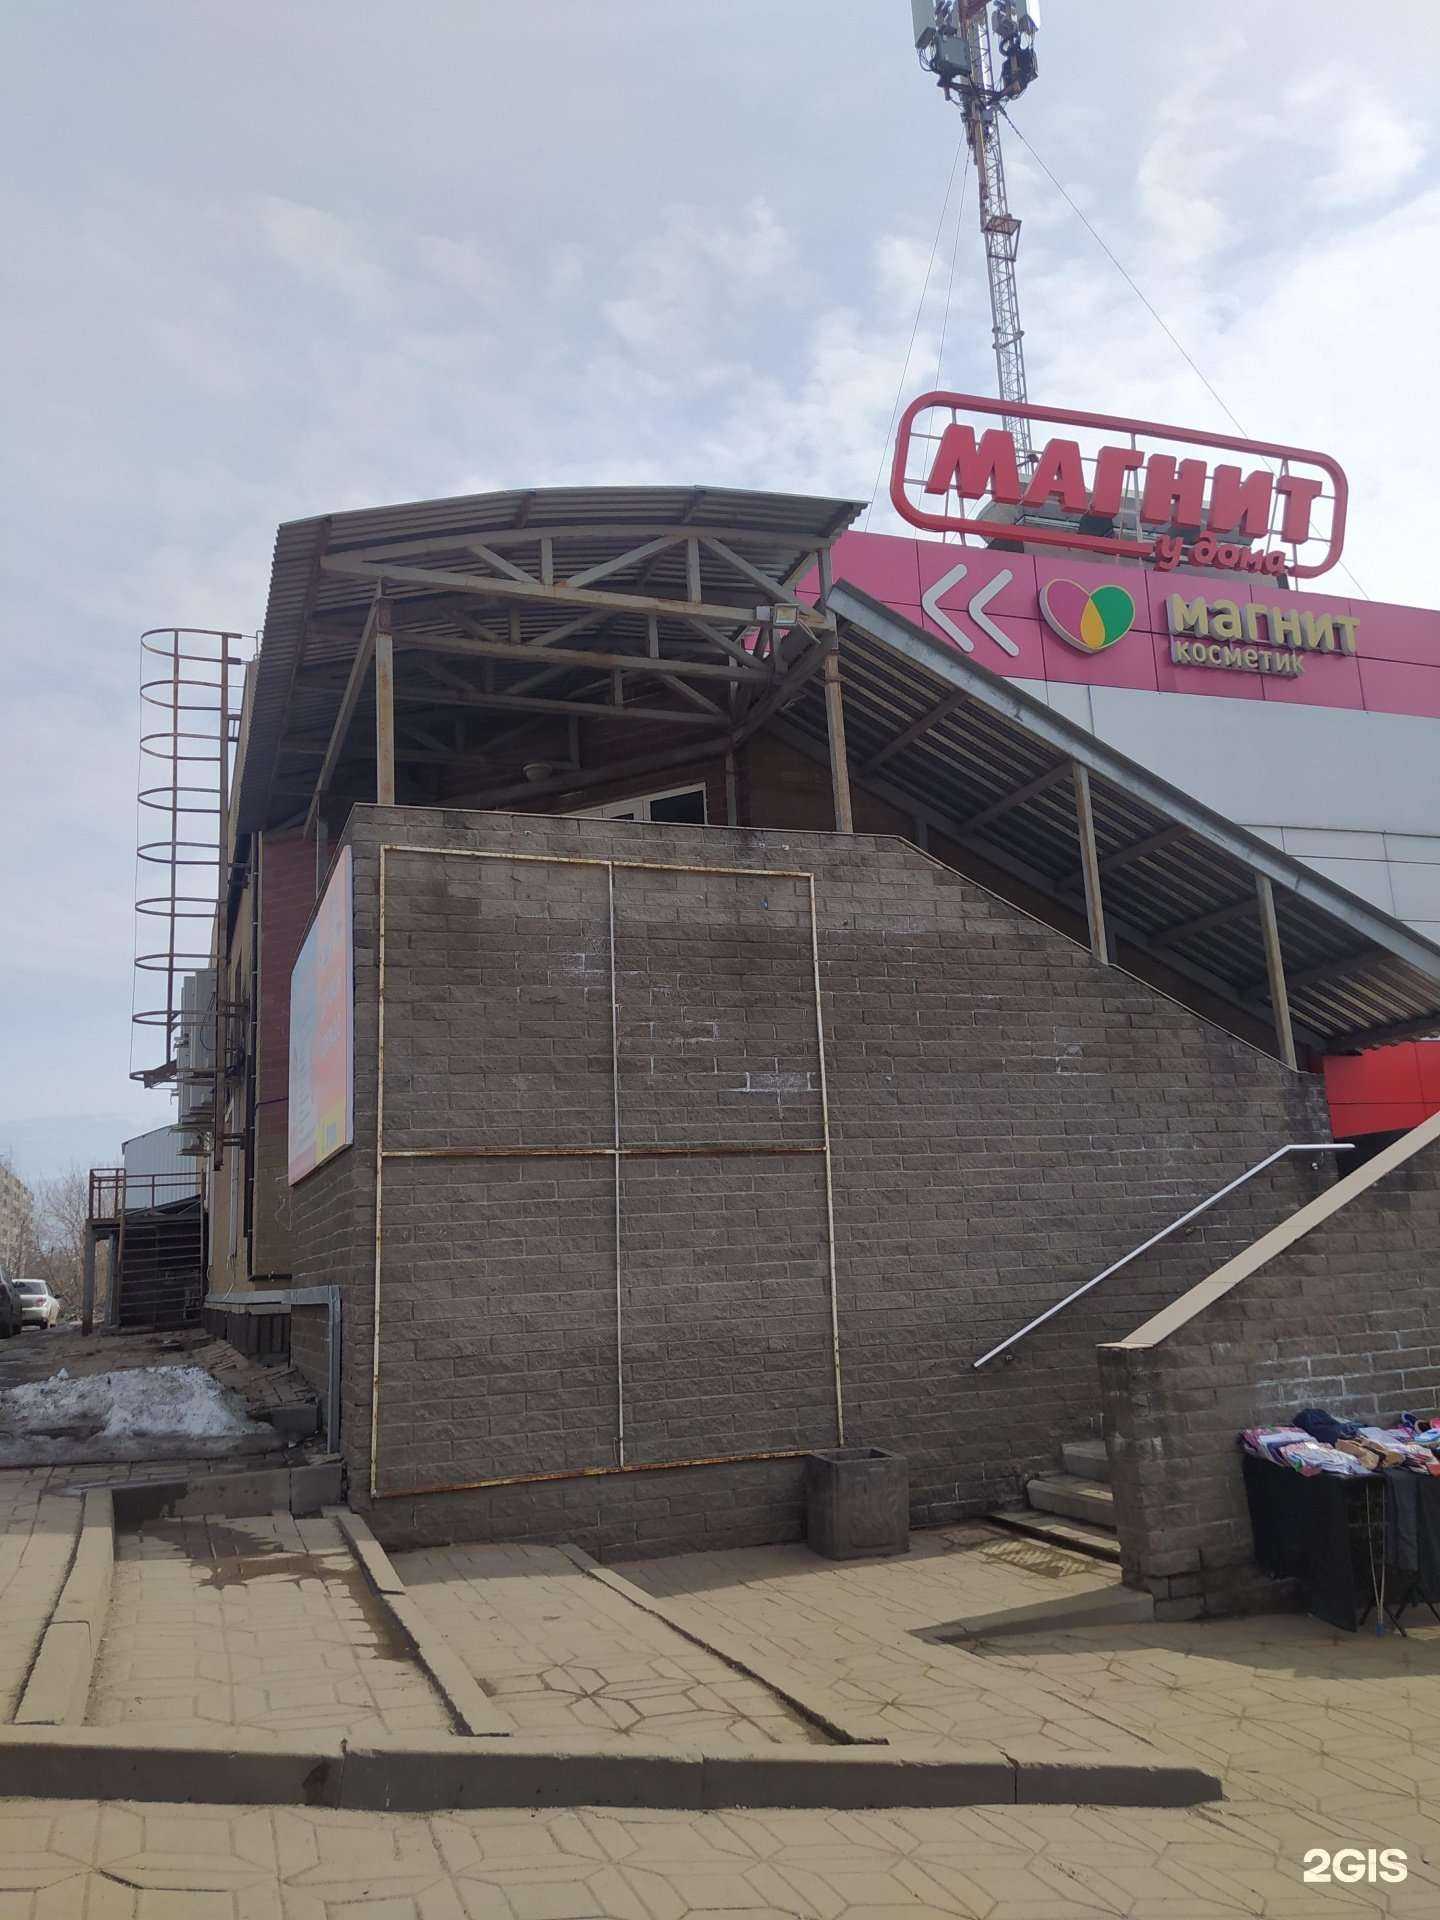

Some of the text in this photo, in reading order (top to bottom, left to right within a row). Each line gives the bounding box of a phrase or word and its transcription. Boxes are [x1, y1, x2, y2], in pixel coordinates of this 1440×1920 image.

[925, 423, 1322, 544] МАГНИТ
[1154, 531, 1287, 576] у дома
[1173, 640, 1304, 677] косметик
